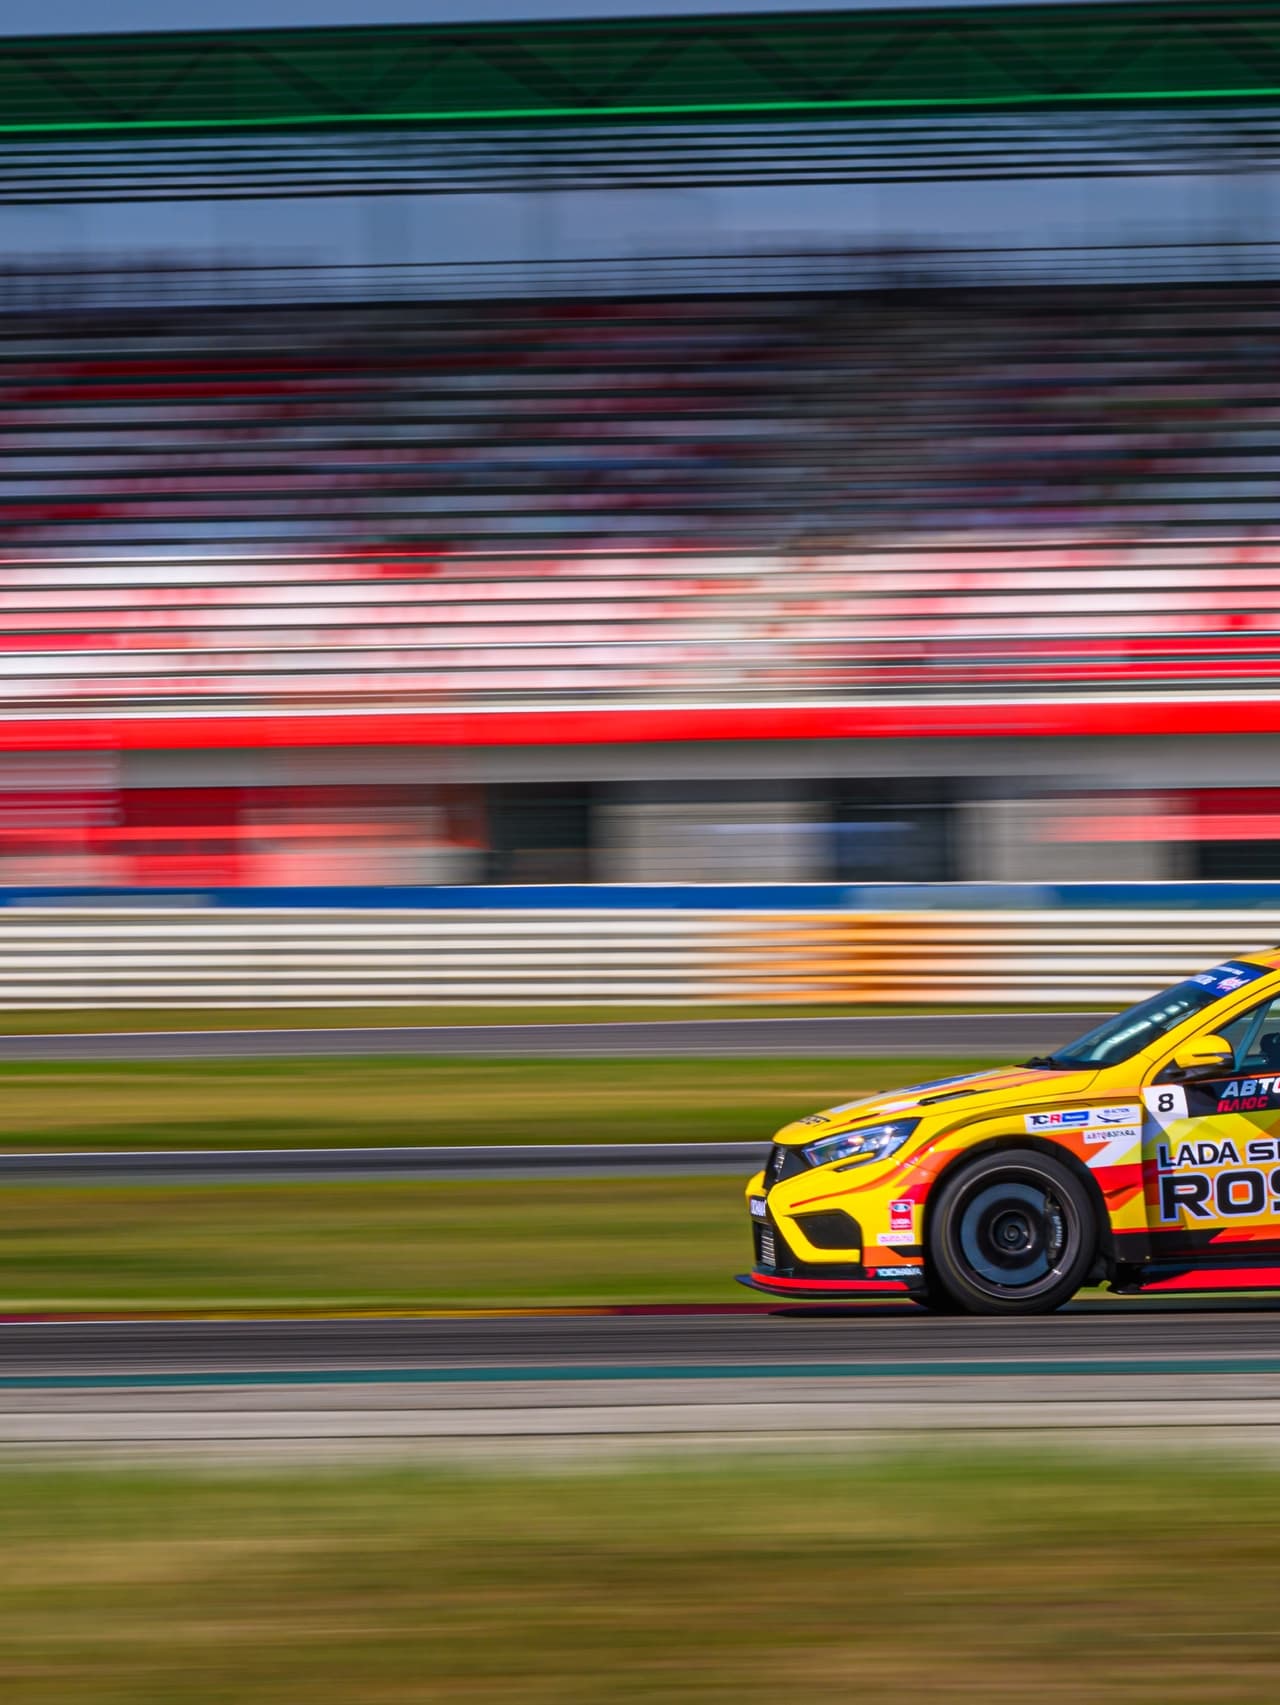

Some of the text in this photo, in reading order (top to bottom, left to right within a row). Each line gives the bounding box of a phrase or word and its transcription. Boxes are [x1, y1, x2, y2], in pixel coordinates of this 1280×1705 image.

[1158, 1093, 1174, 1112] 8
[1217, 1096, 1268, 1112] ПЛЮС
[1158, 1143, 1240, 1169] LADA
